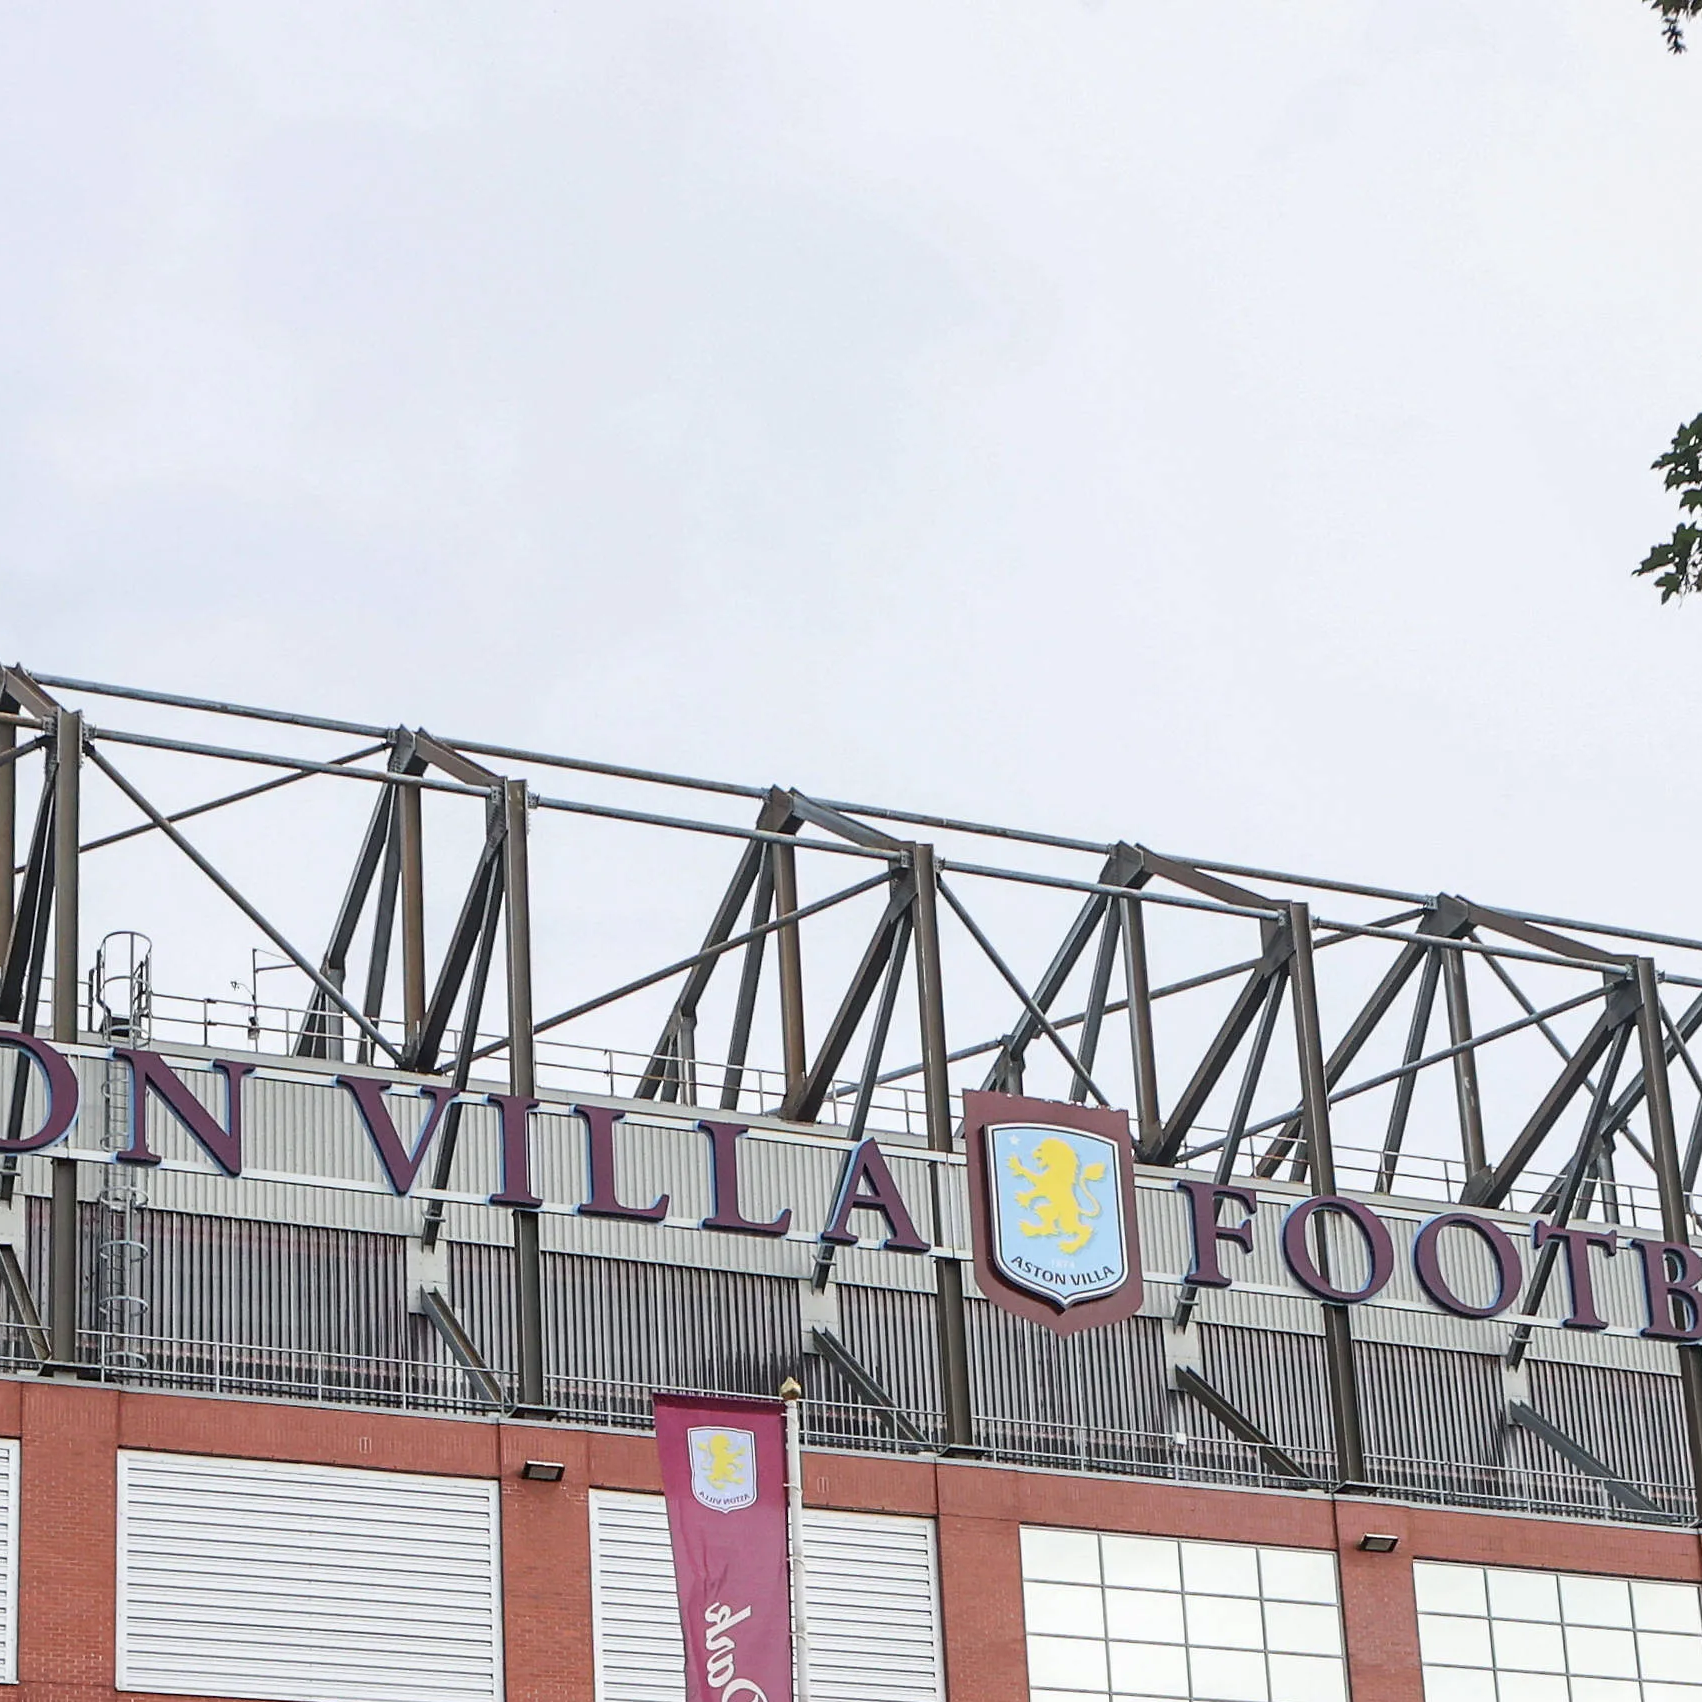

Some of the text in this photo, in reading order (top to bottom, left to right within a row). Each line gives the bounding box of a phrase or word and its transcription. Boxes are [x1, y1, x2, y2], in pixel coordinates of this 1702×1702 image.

[337, 1074, 931, 1253] VILLA
[1011, 1255, 1115, 1286] ASTON VILLA
